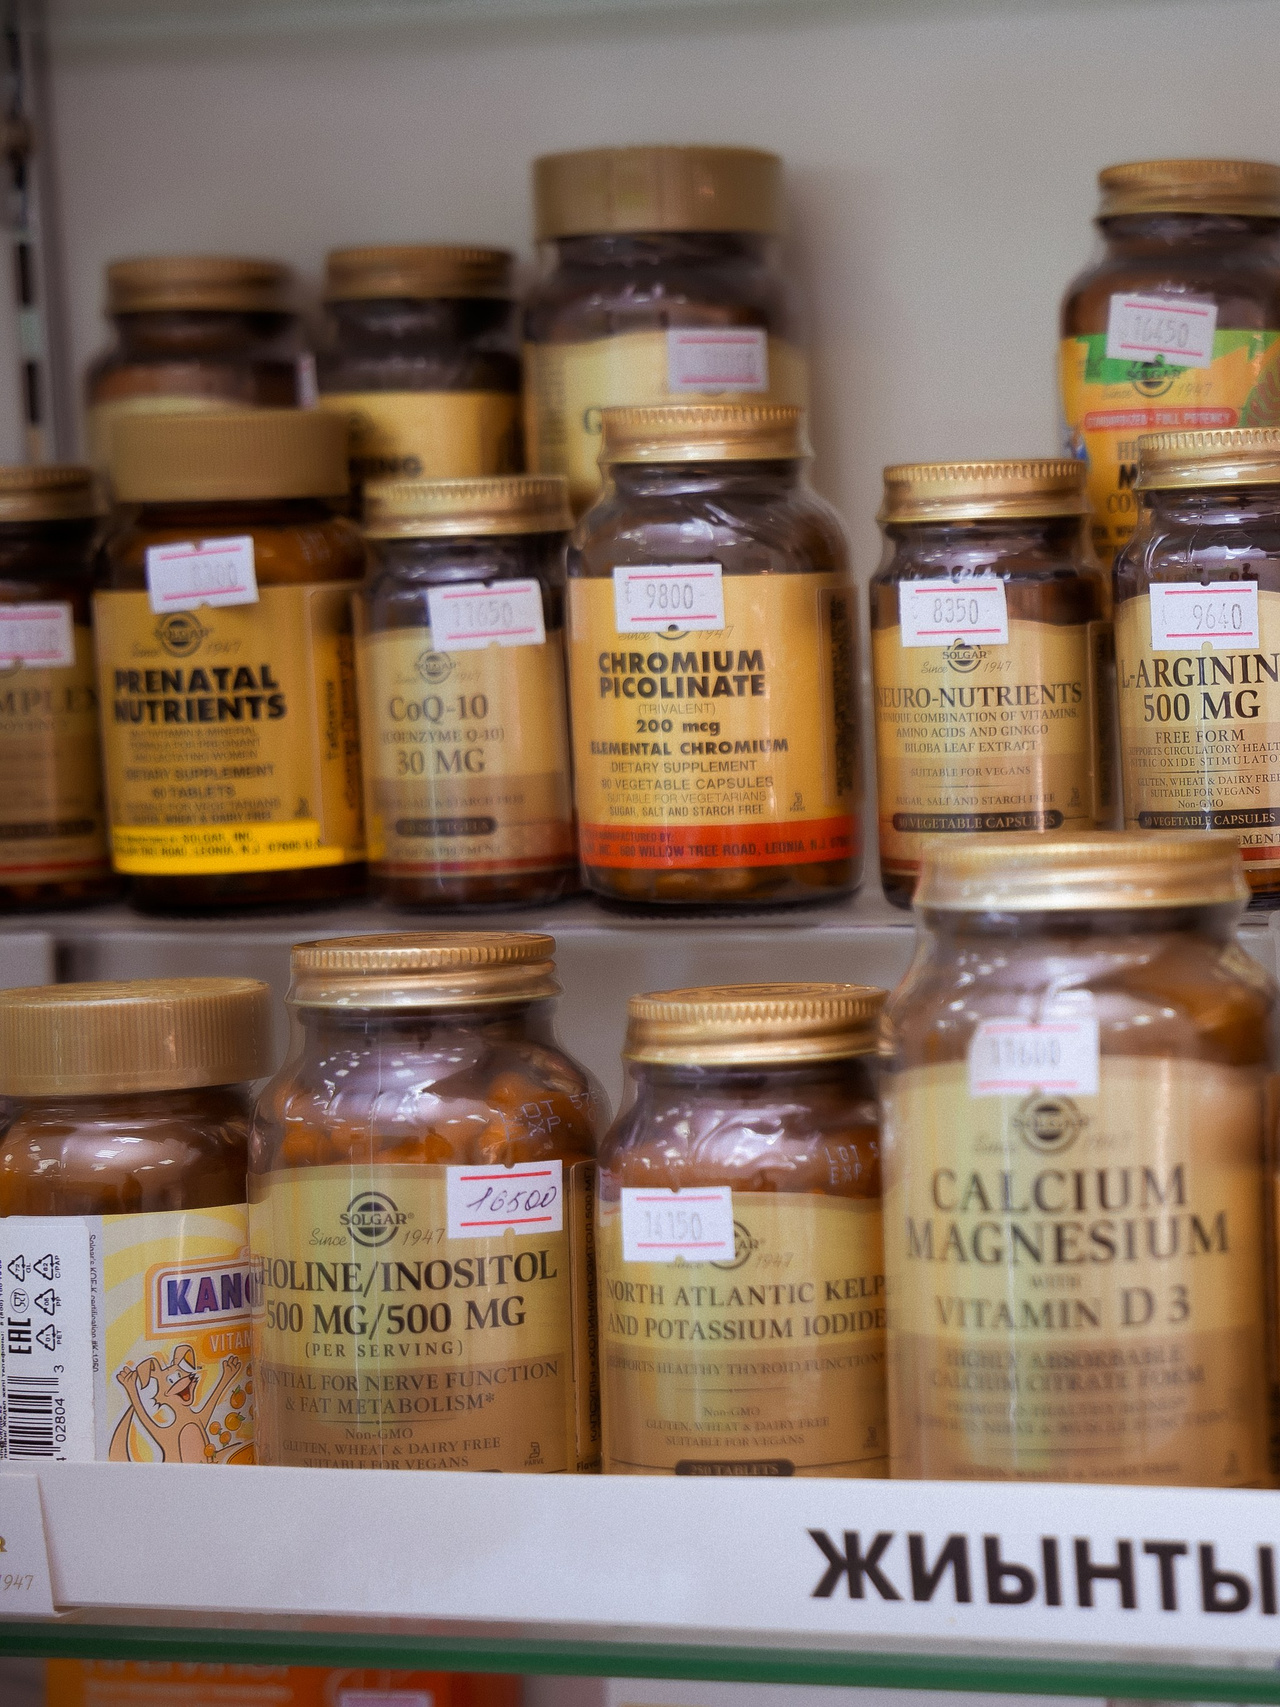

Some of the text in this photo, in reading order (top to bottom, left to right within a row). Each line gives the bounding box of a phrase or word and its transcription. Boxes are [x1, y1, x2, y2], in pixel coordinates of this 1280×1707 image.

[646, 585, 695, 610] 9800
[933, 597, 979, 624] 8350
[598, 649, 765, 675] CHROMIUM
[942, 650, 987, 660] SOLGAR
[115, 664, 278, 694] PRENATAL
[600, 673, 765, 699] PICOLINATE
[115, 694, 286, 723] NUTRIENTS
[389, 695, 488, 723] CoQ-10
[638, 702, 716, 716] (TRIVALENT)
[1143, 691, 1262, 722] 500 MG
[637, 719, 720, 736] 200 mcg
[932, 723, 1050, 737] ACIDS AND GINKGO
[1156, 728, 1245, 744] FREE FORM
[590, 738, 789, 756] ELEMENTAL CHROMIUM
[942, 740, 1038, 754] LEAF EXTRACT
[1164, 743, 1238, 756] CIRCULATORY
[398, 748, 486, 774] 30 MG
[611, 760, 757, 773] DIETARY SUPPLEMENT
[1161, 756, 1195, 767] OXIDE
[614, 776, 774, 790] VEGETABLE CAPSULES
[1219, 773, 1252, 785] DAIRY
[1219, 785, 1261, 796] VEGANS
[1209, 812, 1277, 826] CAPSULES
[930, 1163, 1187, 1214] CALCIUM
[340, 1213, 407, 1226] SOLGAR
[309, 1227, 445, 1247] Since 1947
[906, 1211, 1230, 1265] MAGNESIUM
[607, 1275, 886, 1308] NORTH ATLANTIC KELP
[267, 1296, 526, 1340] 500 MG/500 MG
[934, 1296, 1100, 1329] VITAMIN
[607, 1309, 886, 1341] AND POTASSIUM IODIDE
[305, 1340, 463, 1358] (PER SERVING)
[322, 1360, 559, 1392] FOR NERVE FUNCTION
[300, 1397, 330, 1413] FAT
[345, 1428, 413, 1440] Non-GMO
[335, 1437, 501, 1456] WHEAT DAIRY FREE
[405, 1456, 469, 1469] VEGANS
